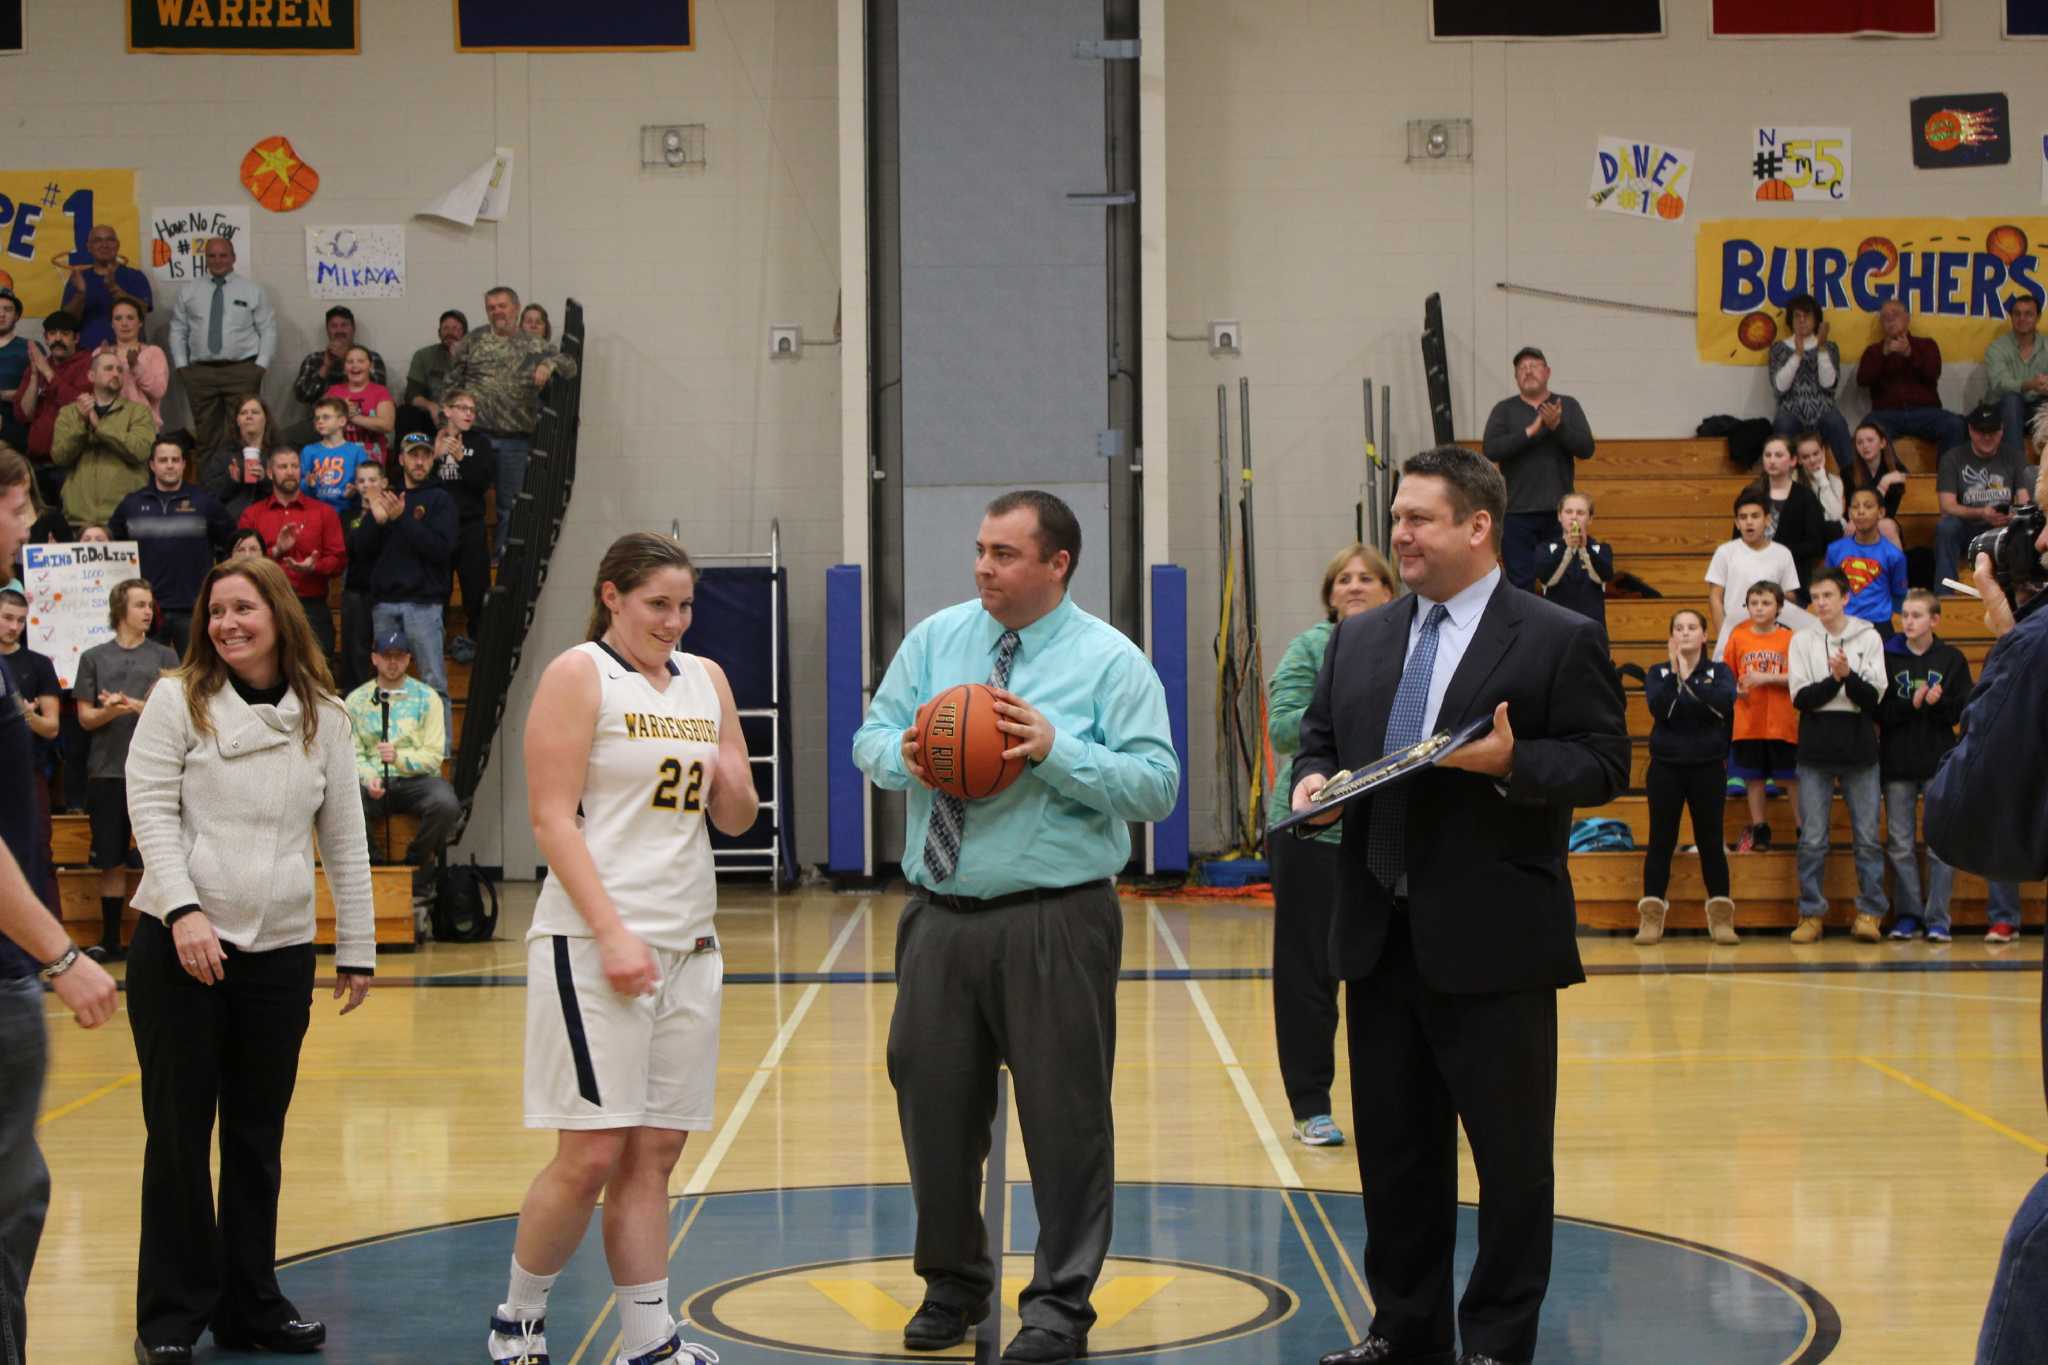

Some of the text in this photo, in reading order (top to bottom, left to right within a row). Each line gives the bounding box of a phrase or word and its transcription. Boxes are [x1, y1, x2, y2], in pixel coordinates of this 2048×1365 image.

[157, 0, 332, 27] WARREN
[189, 212, 208, 232] No
[210, 212, 240, 240] Fear
[1720, 238, 2046, 320] BURGHERS
[931, 703, 957, 737] THE
[651, 757, 705, 811] 22
